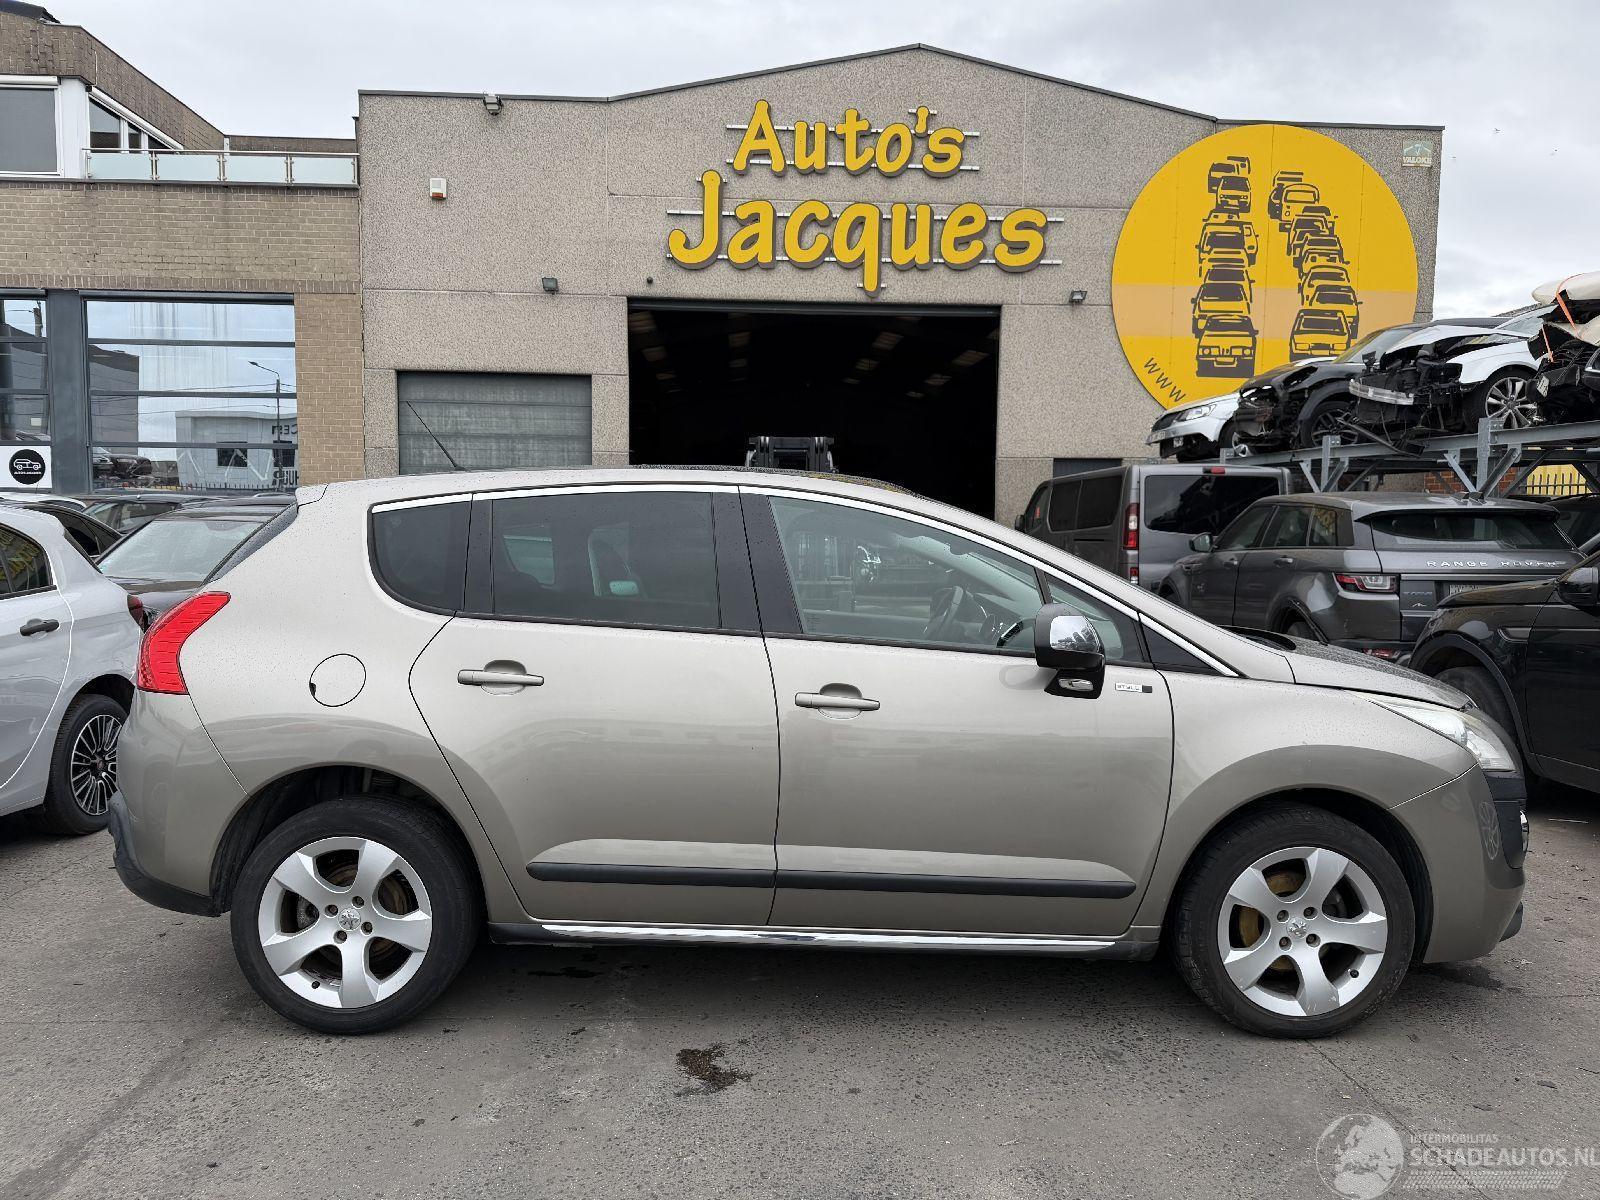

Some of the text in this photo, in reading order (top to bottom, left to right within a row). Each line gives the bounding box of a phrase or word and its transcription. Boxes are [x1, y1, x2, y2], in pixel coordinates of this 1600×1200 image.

[733, 99, 966, 178] Auto's
[667, 169, 1049, 297] Jacques
[1426, 560, 1488, 568] RANGE
